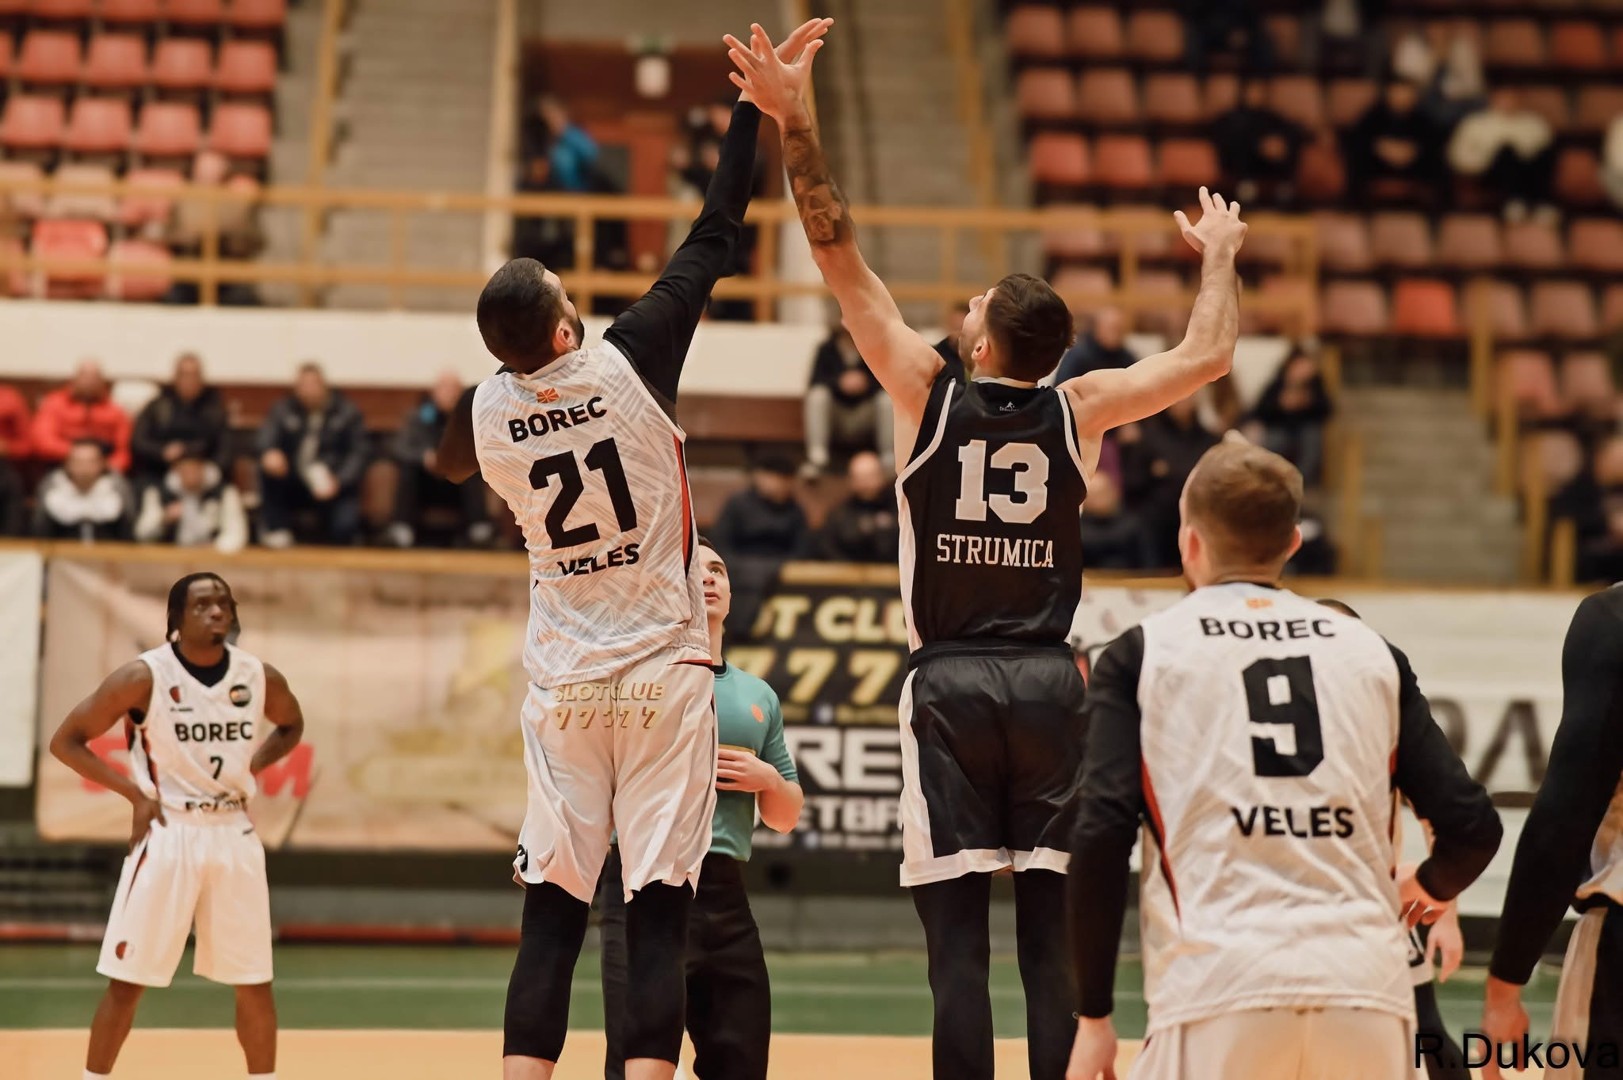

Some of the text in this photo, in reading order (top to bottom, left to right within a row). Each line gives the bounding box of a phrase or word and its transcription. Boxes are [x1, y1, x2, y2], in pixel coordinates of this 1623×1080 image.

[508, 396, 607, 443] BOREC
[528, 437, 638, 549] 21
[955, 439, 1050, 524] 13
[557, 543, 640, 576] VELES
[936, 533, 1055, 568] STRUMICA
[1200, 617, 1337, 641] BOREC
[174, 721, 253, 742] BOREC
[1241, 655, 1325, 778] 9
[209, 755, 224, 780] 7
[1231, 806, 1355, 840] VELES
